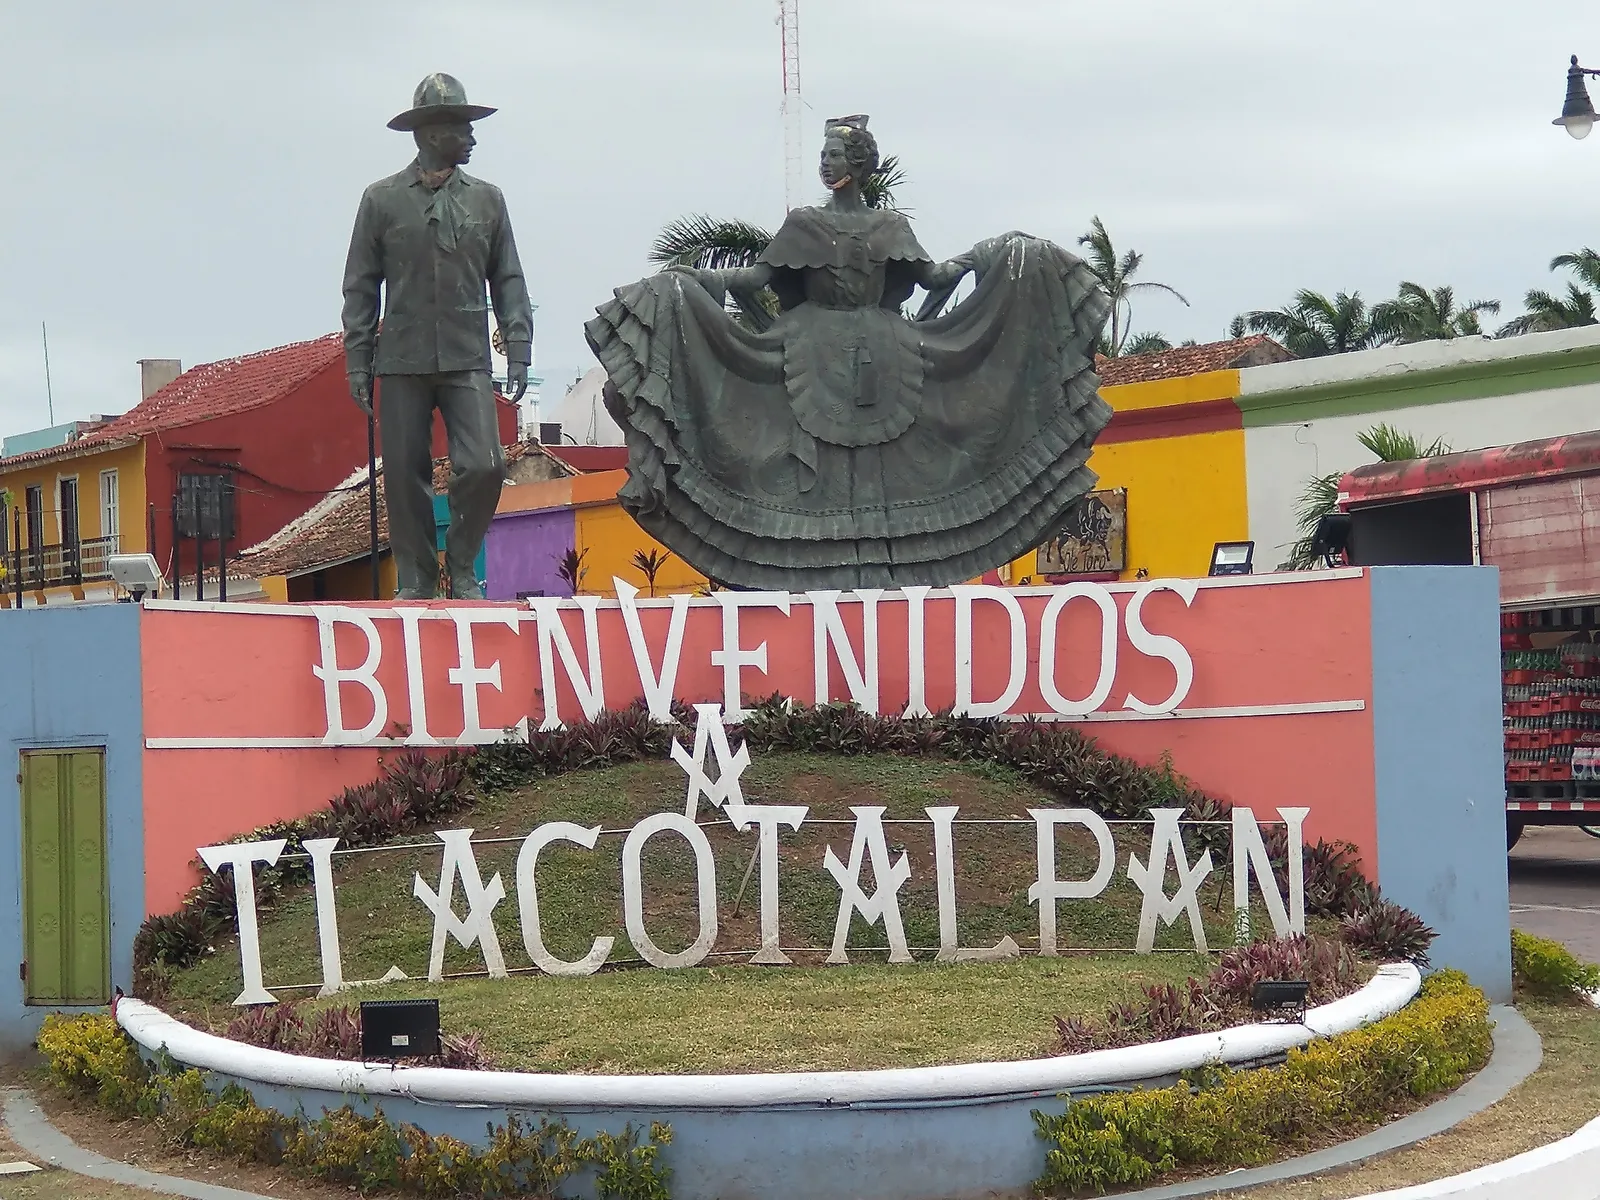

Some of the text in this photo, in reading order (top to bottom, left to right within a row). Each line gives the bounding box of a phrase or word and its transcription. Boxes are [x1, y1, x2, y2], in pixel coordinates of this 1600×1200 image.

[1080, 550, 1106, 571] Toro
[310, 576, 1199, 745] BIENVENIDOS
[670, 703, 751, 831] A
[196, 806, 1310, 1005] TLACOTALPAN
